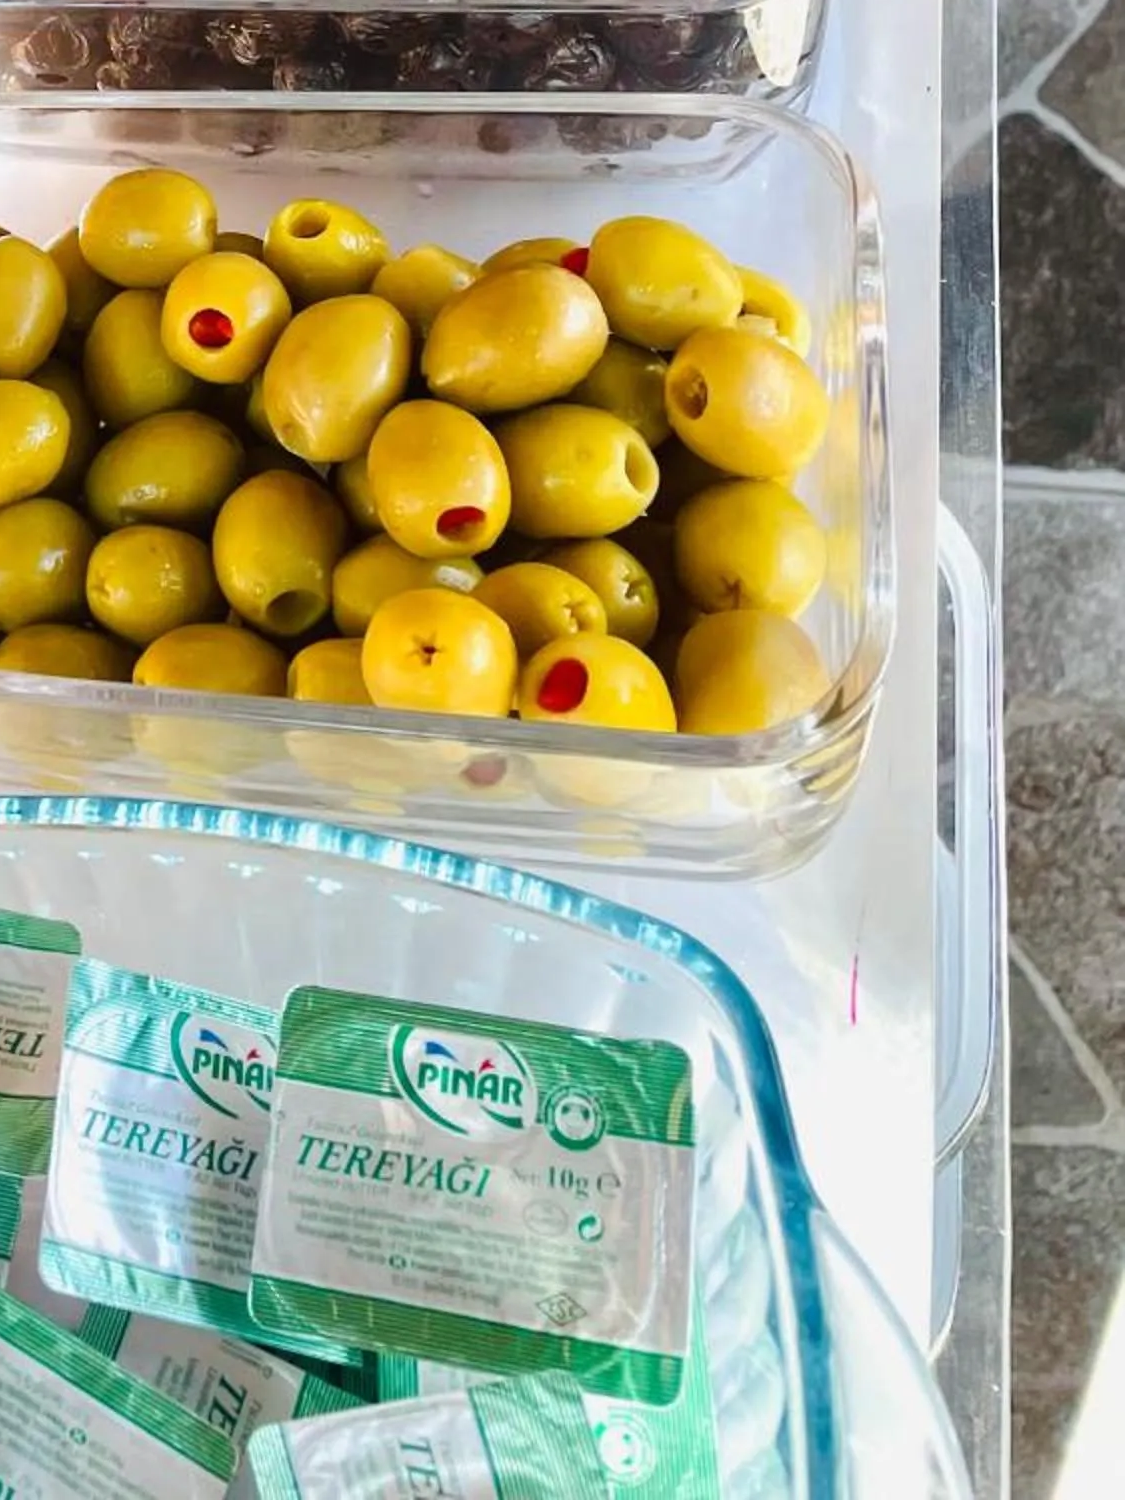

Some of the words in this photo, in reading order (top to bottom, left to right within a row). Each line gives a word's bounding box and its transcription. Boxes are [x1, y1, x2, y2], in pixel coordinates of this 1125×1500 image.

[417, 1061, 525, 1109] PINAR
[78, 1104, 261, 1182] TEREYAĞI
[294, 1133, 491, 1198] TEREYAĞI
[546, 1164, 590, 1199] 10g
